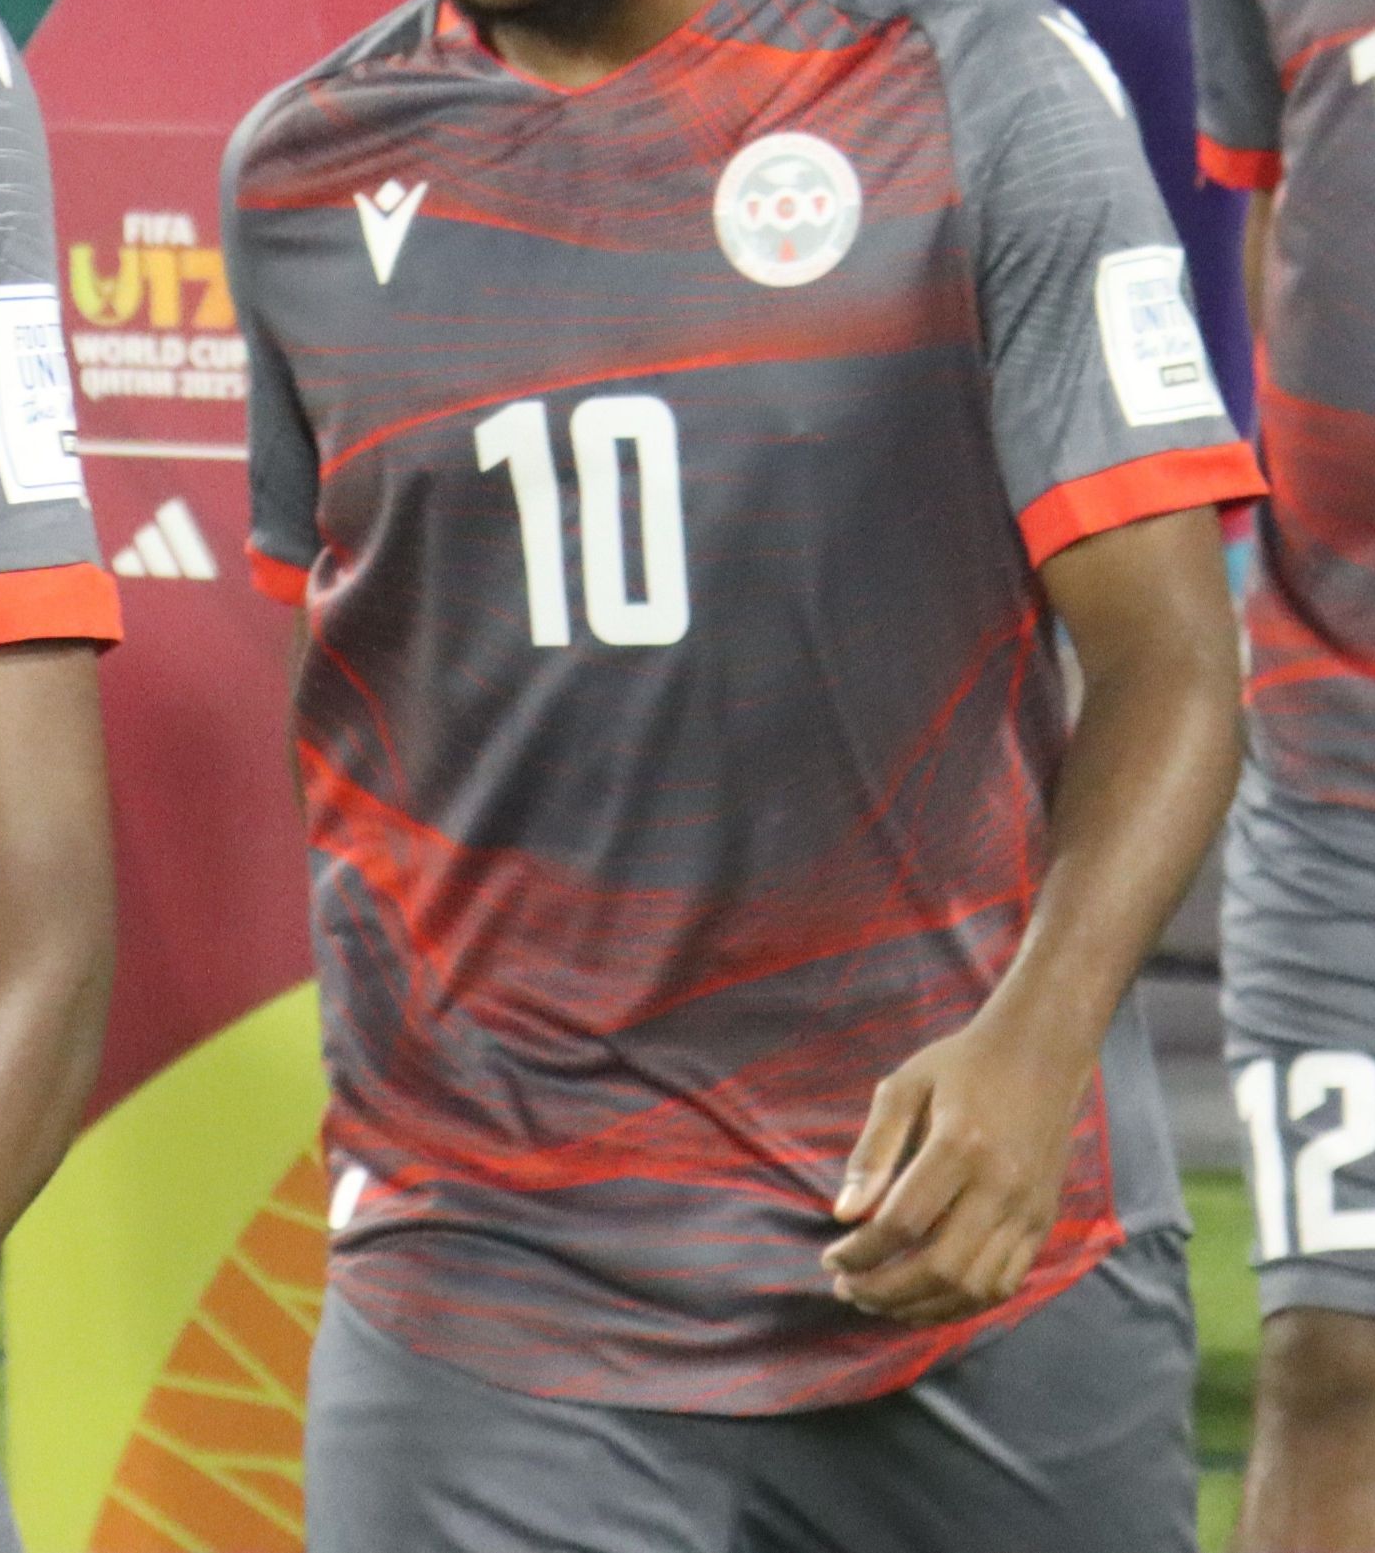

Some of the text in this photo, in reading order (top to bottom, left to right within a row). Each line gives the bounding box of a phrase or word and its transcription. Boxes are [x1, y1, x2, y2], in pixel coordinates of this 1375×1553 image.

[122, 211, 197, 246] FIFA
[72, 333, 186, 368] WORLD
[80, 366, 177, 401] QATAR
[474, 395, 692, 647] 10
